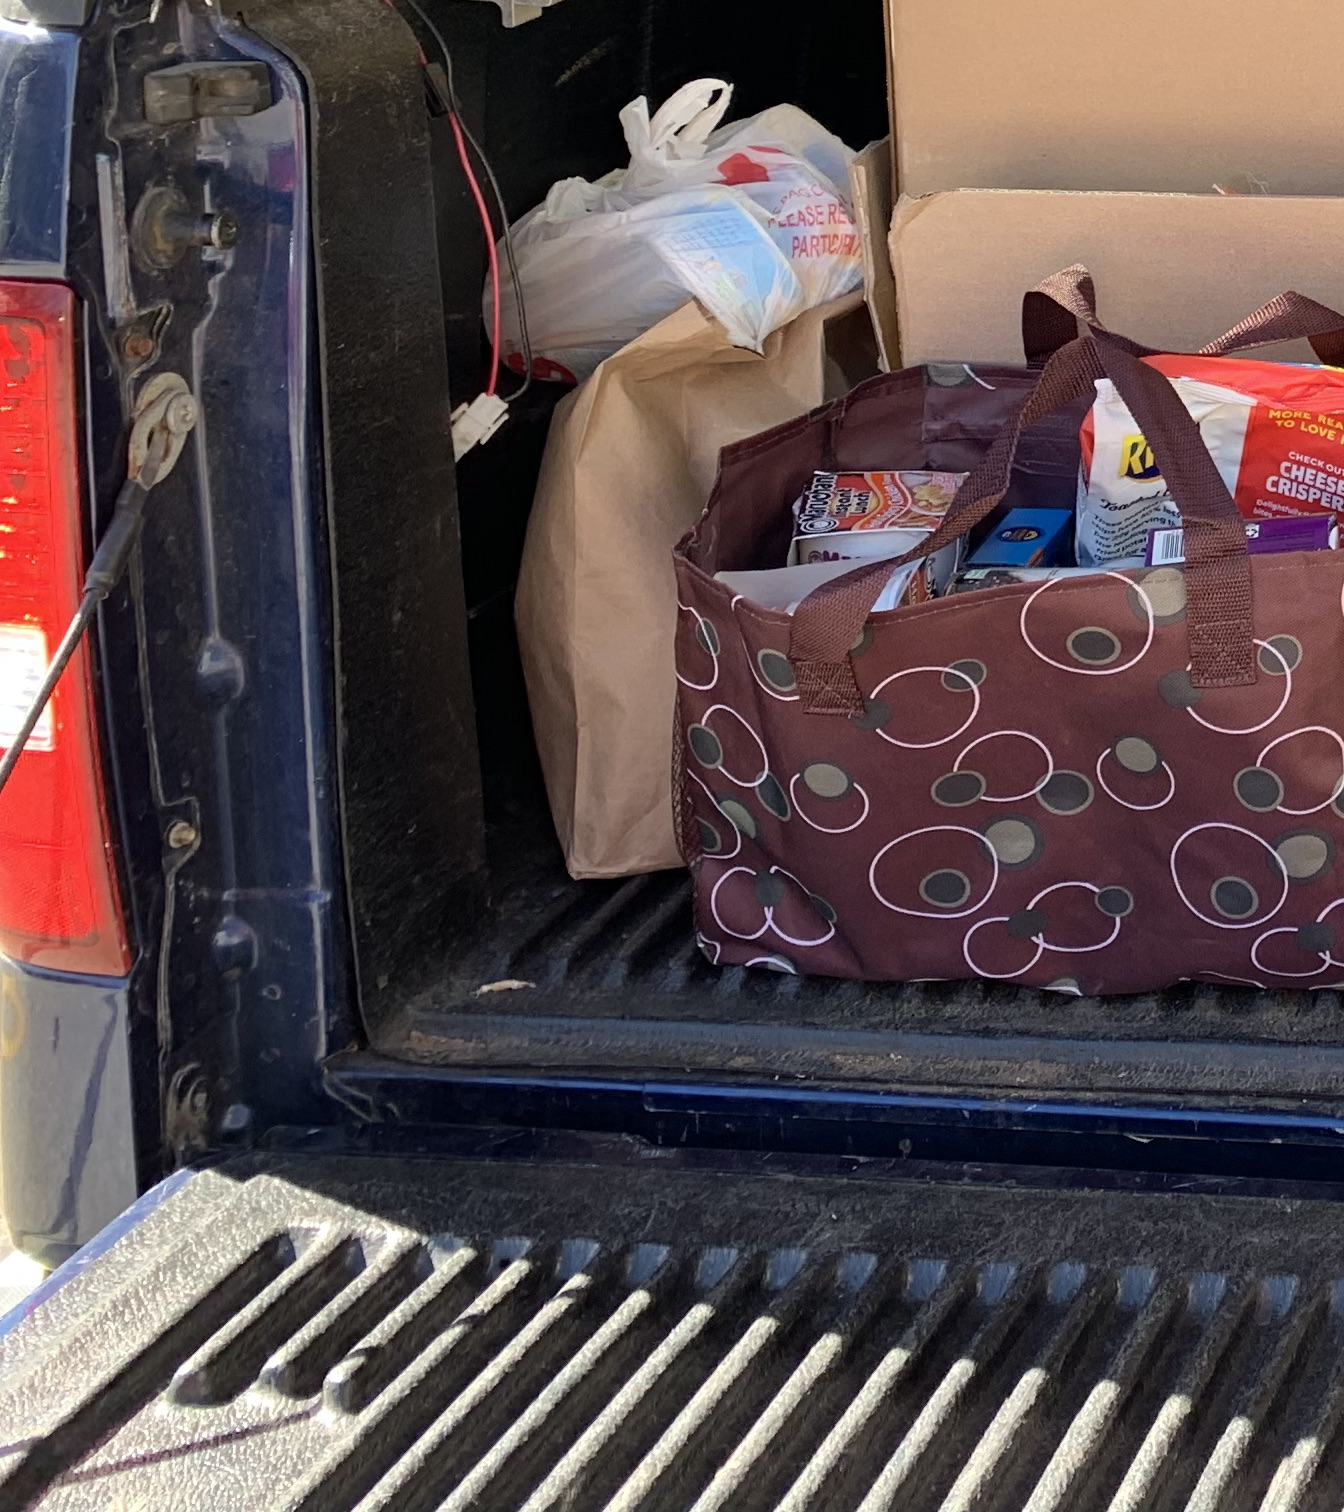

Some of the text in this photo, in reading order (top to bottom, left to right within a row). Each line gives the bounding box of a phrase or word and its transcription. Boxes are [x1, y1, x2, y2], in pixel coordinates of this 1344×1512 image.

[1276, 419, 1295, 428] TO
[1301, 421, 1336, 441] LOVE
[1288, 451, 1325, 468] CHECK
